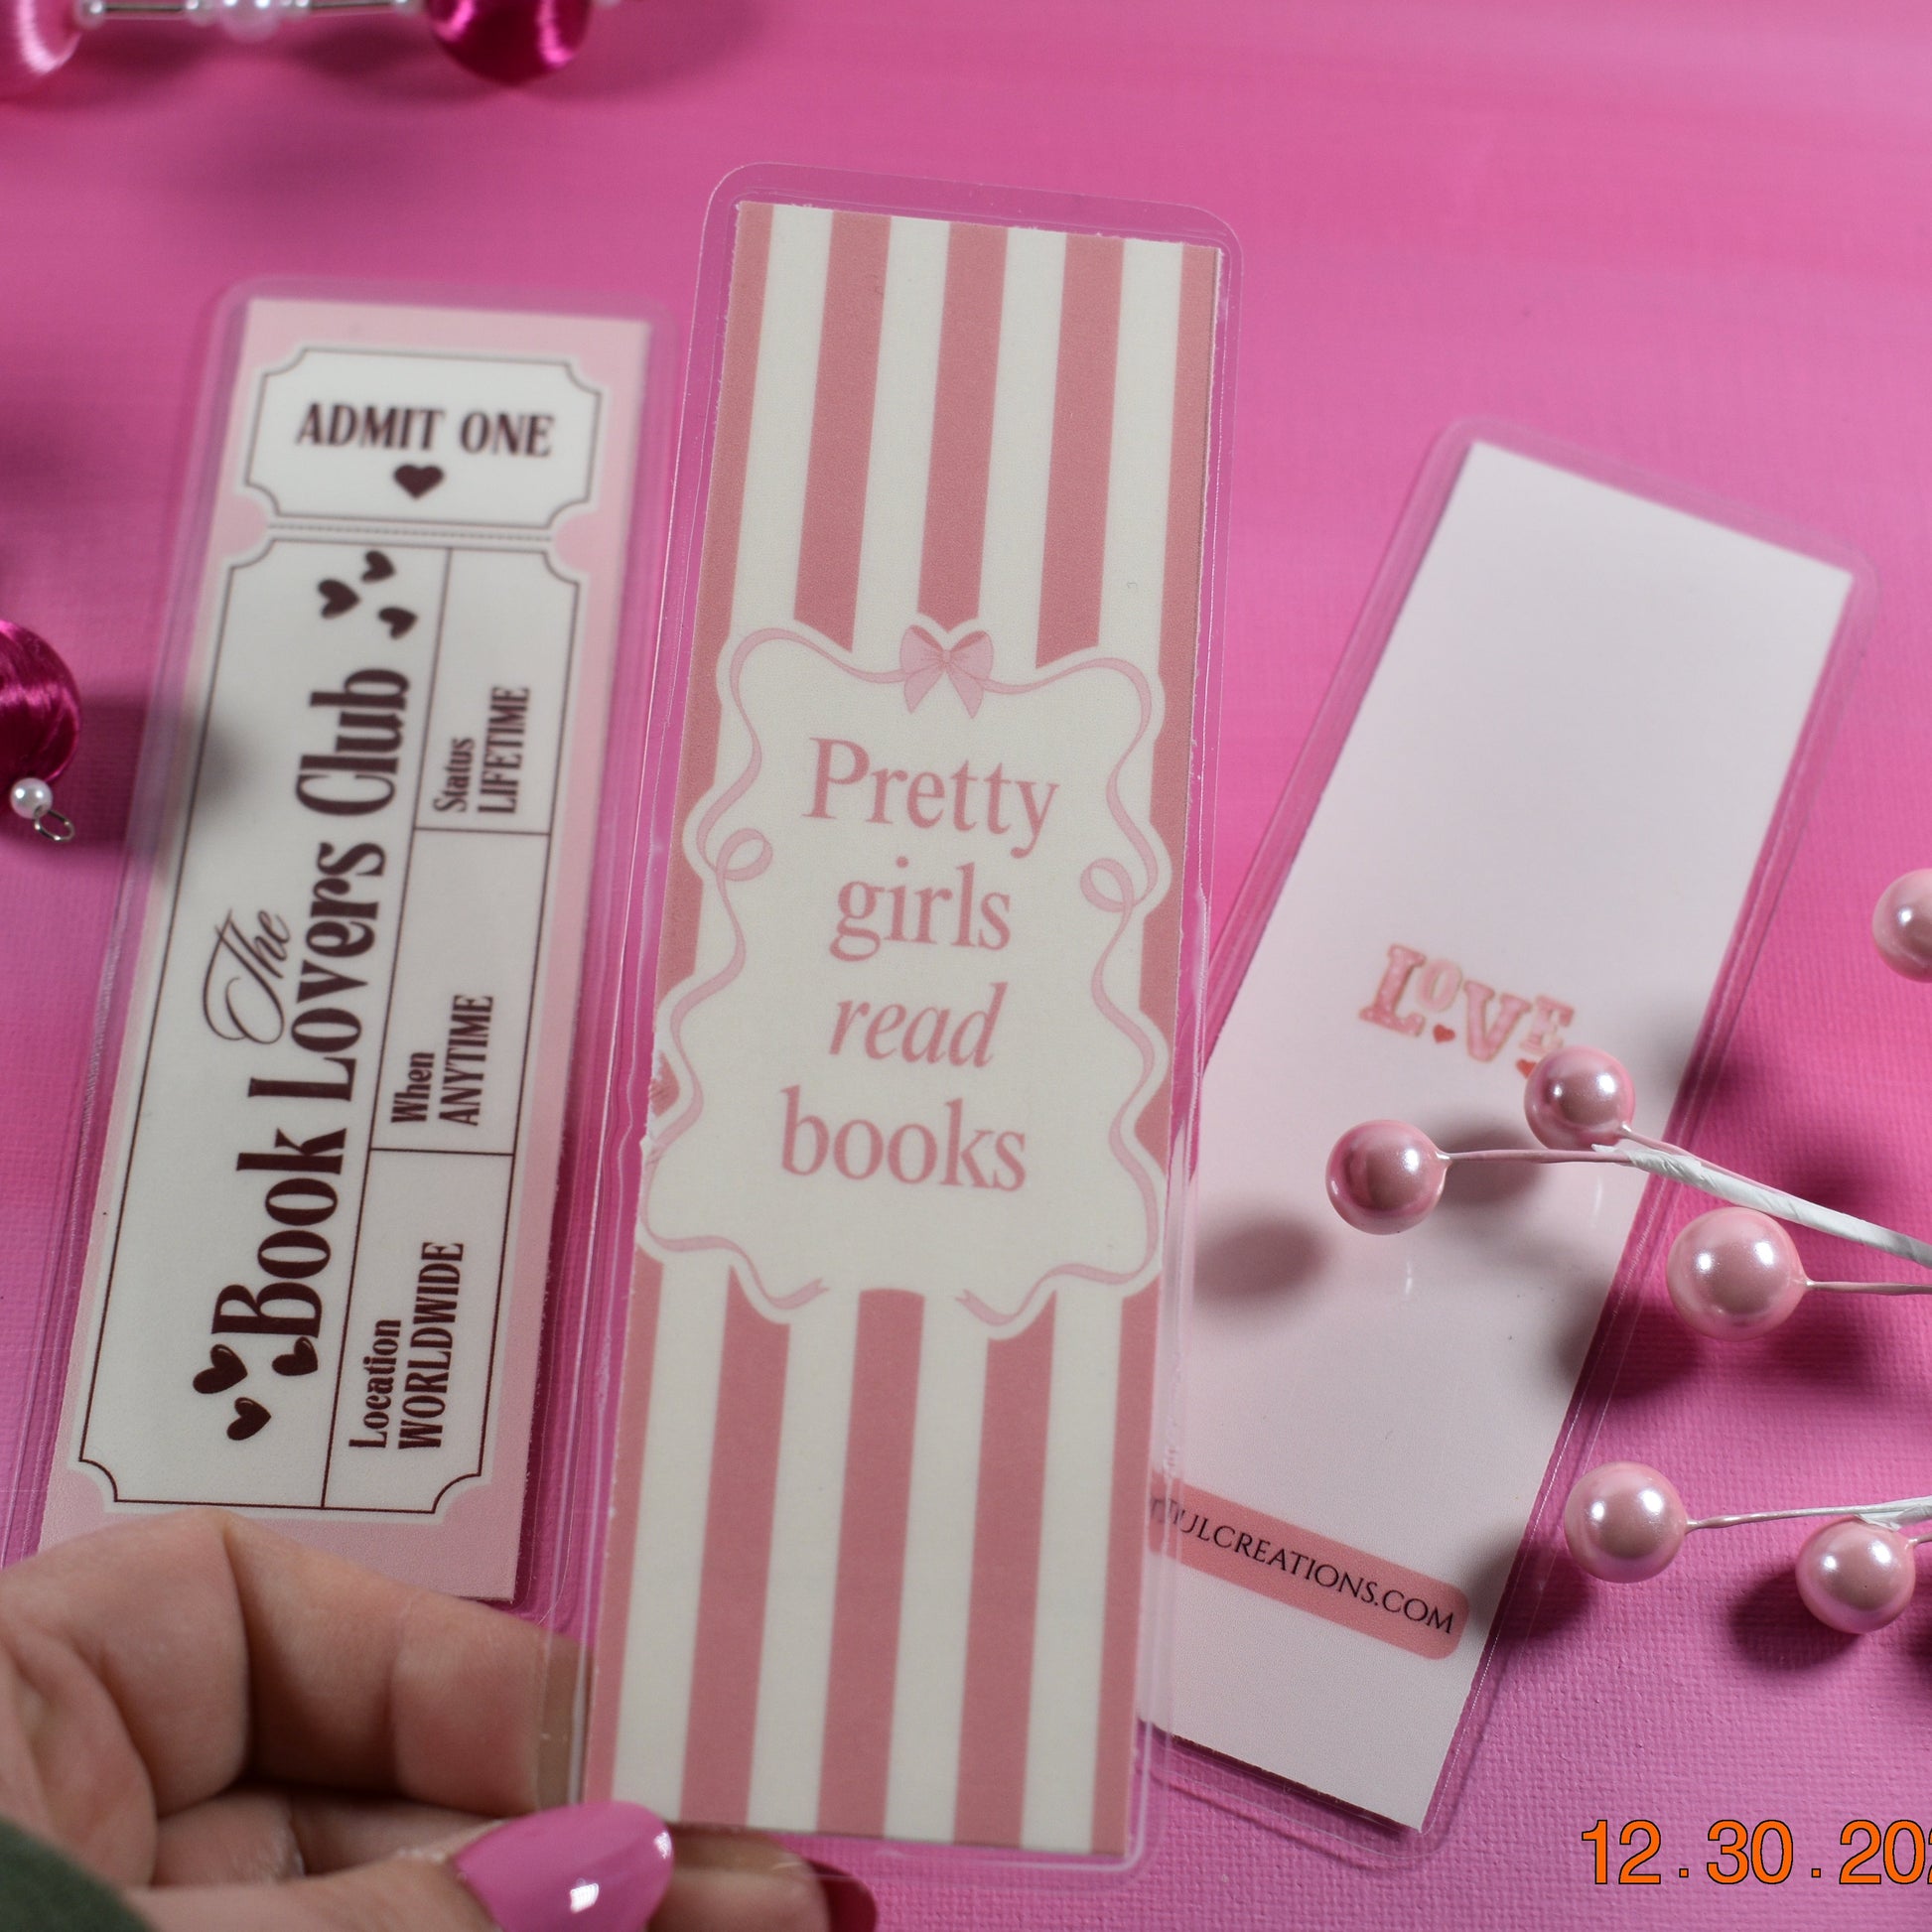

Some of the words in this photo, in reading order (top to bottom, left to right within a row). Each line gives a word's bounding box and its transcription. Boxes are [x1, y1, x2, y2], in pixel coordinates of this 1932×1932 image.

[297, 402, 445, 452] ADMIT
[460, 411, 553, 458] ONE
[294, 668, 411, 817] Club
[433, 738, 475, 812] Status
[478, 687, 529, 814] LIFETIME
[801, 736, 1060, 860] Pretty
[828, 855, 1012, 963] girls
[202, 908, 291, 1045] The
[246, 842, 386, 1102] Lovers
[828, 981, 1009, 1068] read
[1358, 943, 1575, 1062] LOVE
[390, 1051, 436, 1124] When
[438, 995, 494, 1127] ANYTIME
[780, 1084, 1027, 1192] books
[210, 1128, 348, 1338] Book
[348, 1319, 401, 1449] Location
[397, 1242, 465, 1450] WORLDWIDE
